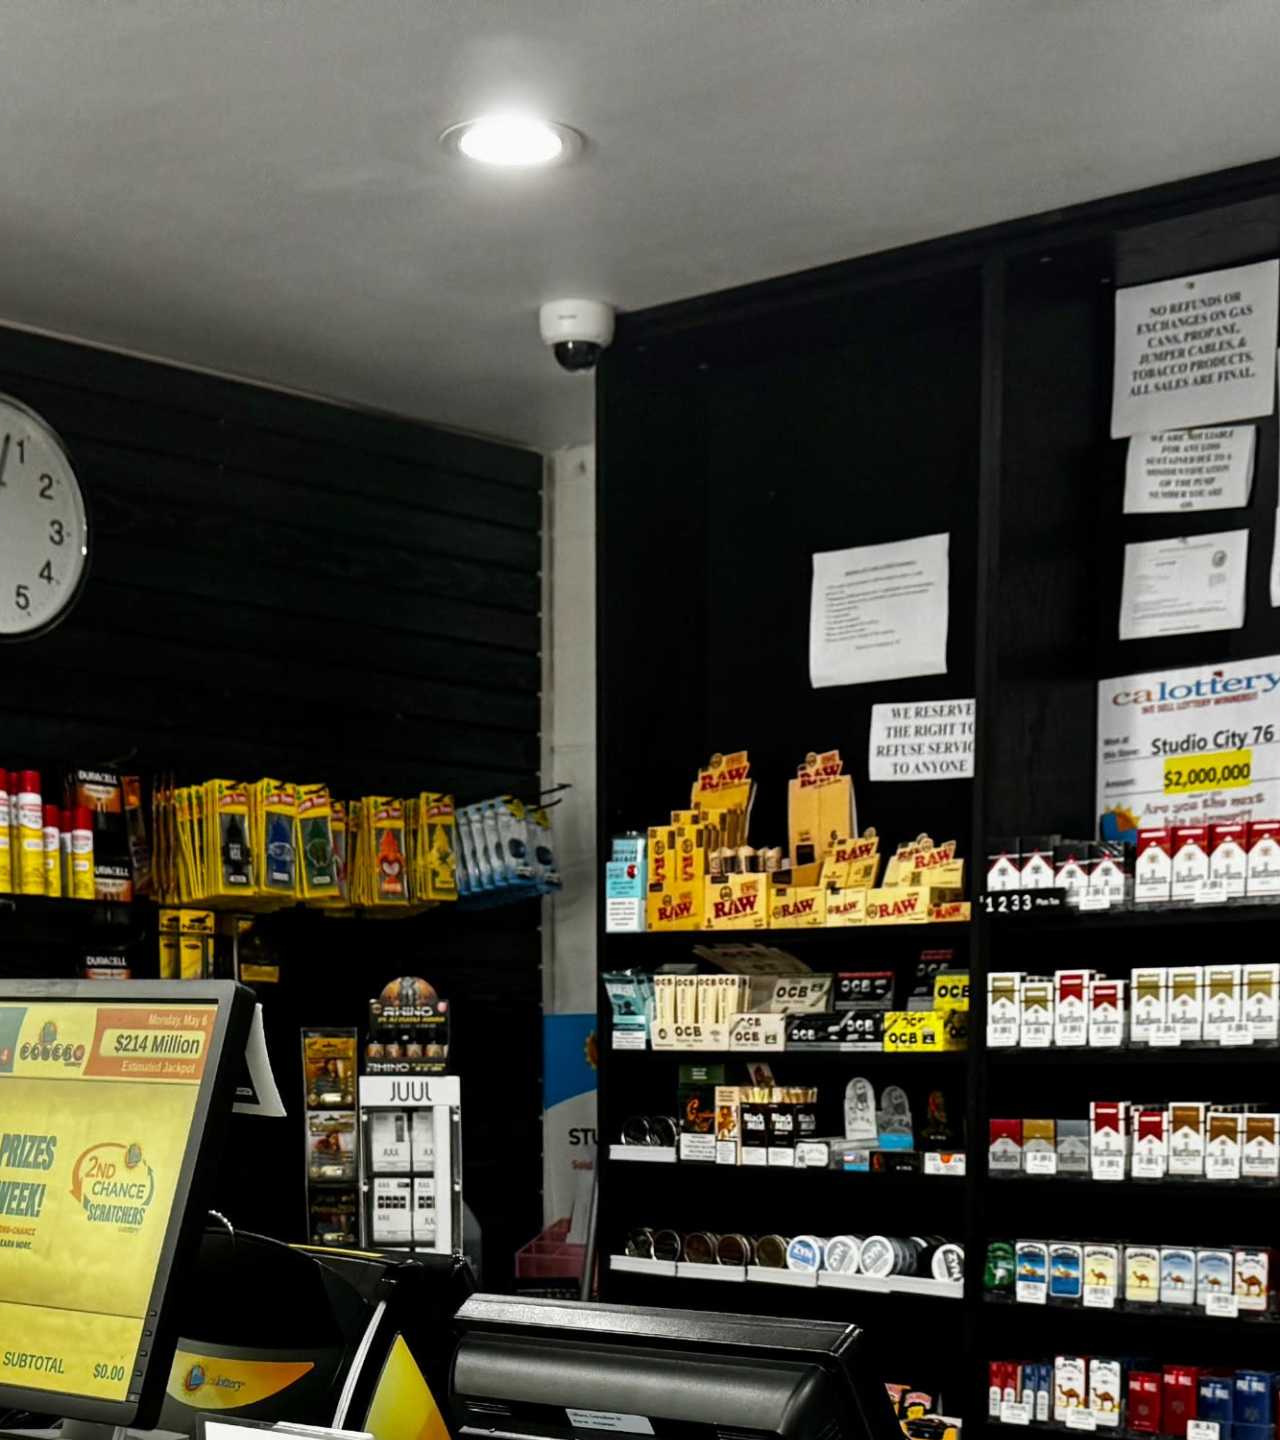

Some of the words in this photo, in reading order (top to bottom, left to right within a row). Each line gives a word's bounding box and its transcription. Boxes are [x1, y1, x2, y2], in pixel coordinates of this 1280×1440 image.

[1149, 305, 1167, 316] NO
[1169, 294, 1222, 313] REFUNDS
[1136, 313, 1208, 335] EXCHANGES
[1210, 311, 1226, 323] ON
[1229, 305, 1253, 319] GAS
[1132, 363, 1188, 382] TOBACCO
[1130, 383, 1150, 397] ALL
[1154, 378, 1189, 392] SALES
[1192, 373, 1213, 386] ARE
[17, 440, 25, 463] 1
[40, 474, 53, 498] 2
[49, 522, 64, 545] 3
[40, 562, 54, 583] 4
[15, 586, 30, 609] 5
[892, 707, 910, 720] WE
[885, 726, 911, 738] THE
[913, 723, 955, 738] RIGHT
[1151, 729, 1208, 756] Studio
[1213, 727, 1247, 750] City
[1253, 724, 1275, 743] 76
[876, 744, 925, 757] REFUSE
[892, 762, 910, 775] TO
[913, 759, 967, 774] ANYONE
[1163, 762, 1252, 789] $2,000,000
[699, 765, 747, 792] RAW
[714, 894, 757, 917] RAW
[878, 897, 918, 917] RAW
[776, 985, 808, 998] OCB
[114, 1034, 148, 1053] $214
[151, 1034, 200, 1054] Million
[889, 1032, 918, 1044] OCB
[390, 1081, 432, 1103] JUUL
[85, 1156, 116, 1179] 2ND
[92, 1181, 145, 1200] CHANCE
[87, 1203, 146, 1225] SCRATCHERS
[3, 1351, 65, 1375] SUBTOTAL
[93, 1362, 125, 1383] $0.00
